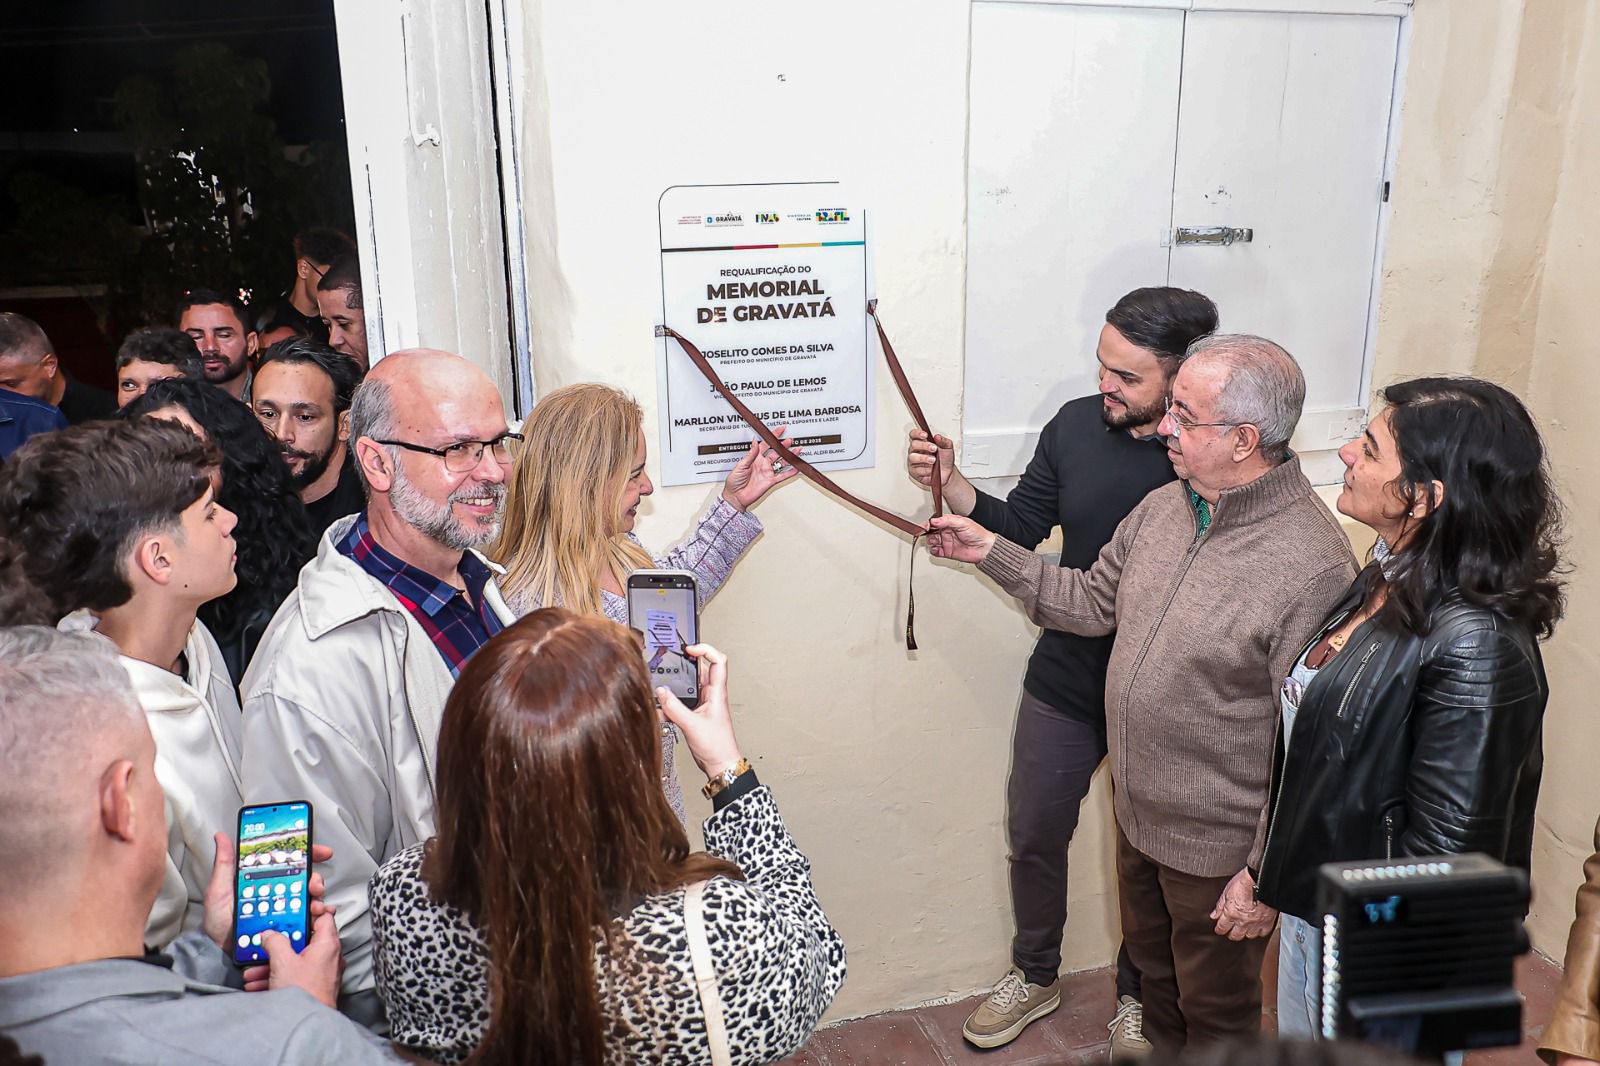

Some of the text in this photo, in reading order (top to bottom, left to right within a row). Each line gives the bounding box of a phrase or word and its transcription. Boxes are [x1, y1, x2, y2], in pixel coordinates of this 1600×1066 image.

[815, 211, 850, 222] BRASIL
[720, 265, 811, 277] REQUALIFICAÇÃO DO
[707, 279, 825, 300] MEMORIAL
[697, 296, 836, 324] DE GRAVATÁ
[702, 343, 834, 359] JOSELITO GOMES DA SILVA
[741, 380, 775, 391] PAULO
[776, 379, 791, 388] DE
[793, 376, 827, 387] LEMOS
[674, 405, 861, 427] MARLLON VINUS DE LIMA BARBOSA
[699, 424, 732, 432] SECRETÁRIO
[706, 457, 732, 465] RECURSO
